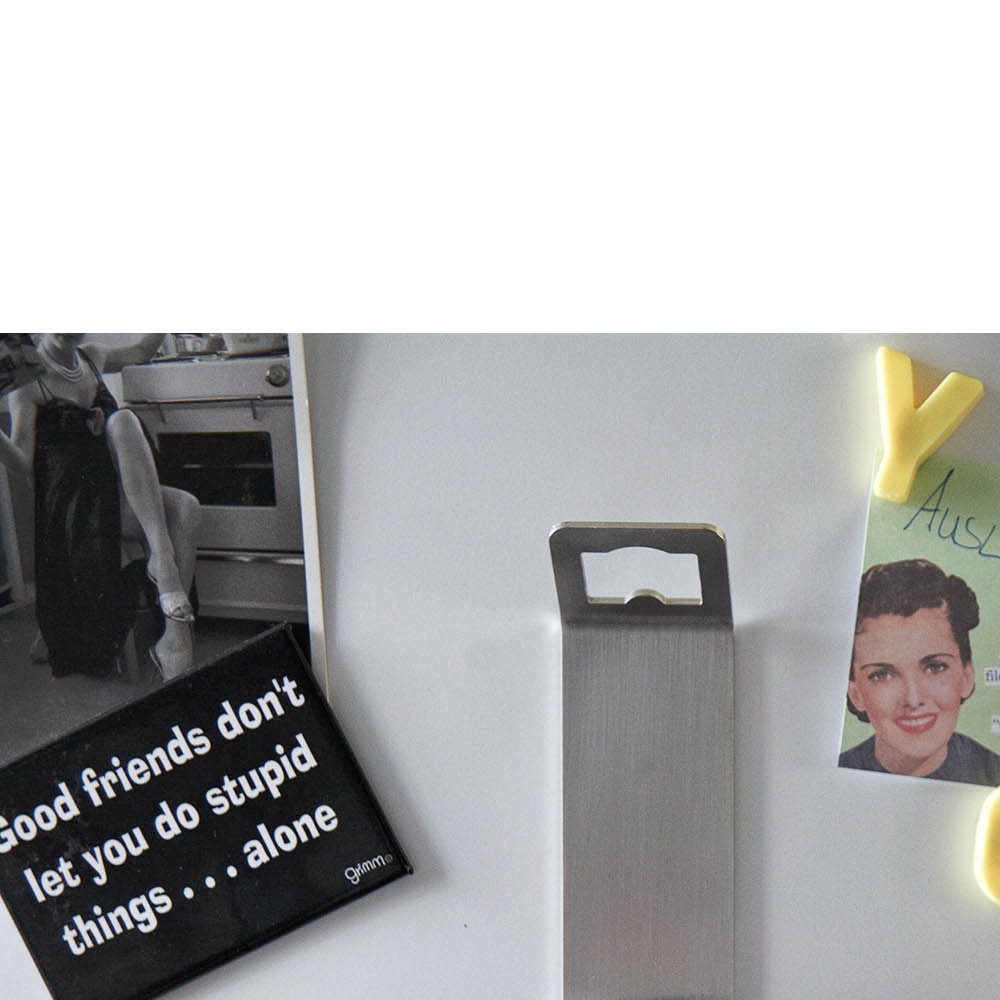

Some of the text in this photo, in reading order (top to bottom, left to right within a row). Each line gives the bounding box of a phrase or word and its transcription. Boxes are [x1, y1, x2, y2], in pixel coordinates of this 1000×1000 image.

[873, 346, 984, 503] Y
[23, 733, 318, 902] let you do stupid
[81, 726, 212, 807] friends
[216, 675, 305, 740] don't
[62, 804, 338, 956] things alone
